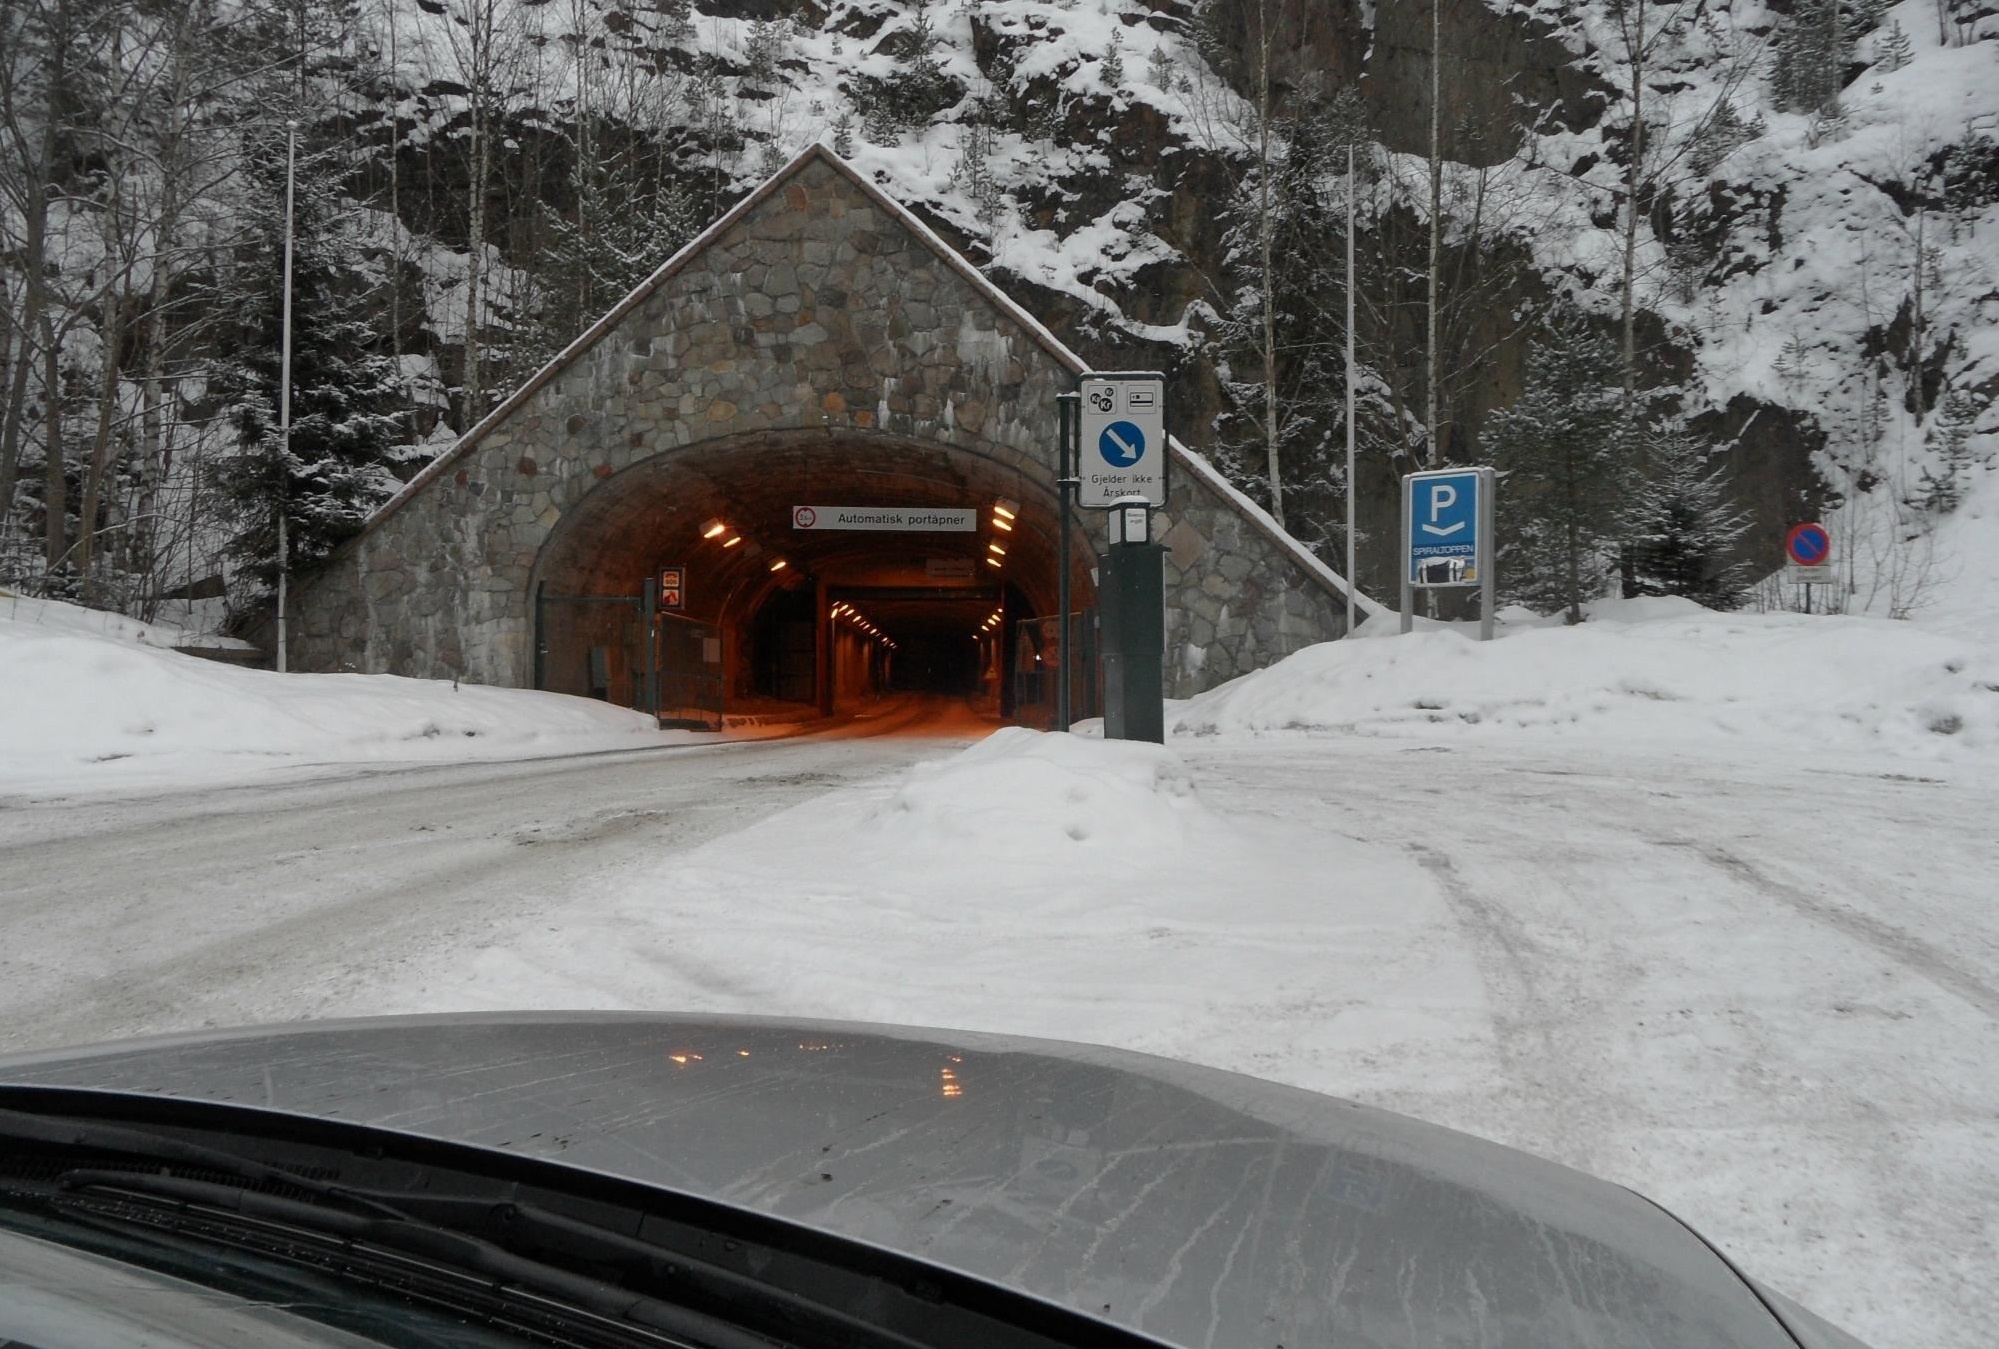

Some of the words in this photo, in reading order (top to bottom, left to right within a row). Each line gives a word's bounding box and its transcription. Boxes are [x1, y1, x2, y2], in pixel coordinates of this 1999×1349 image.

[1091, 474, 1127, 486] Gjelder
[1132, 474, 1152, 484] ikke
[1103, 486, 1141, 497] Årskort
[1431, 485, 1456, 522] P
[838, 513, 903, 524] Automatisk
[908, 514, 966, 526] portåpner
[1413, 544, 1474, 556] SPIRALTOPPEN
